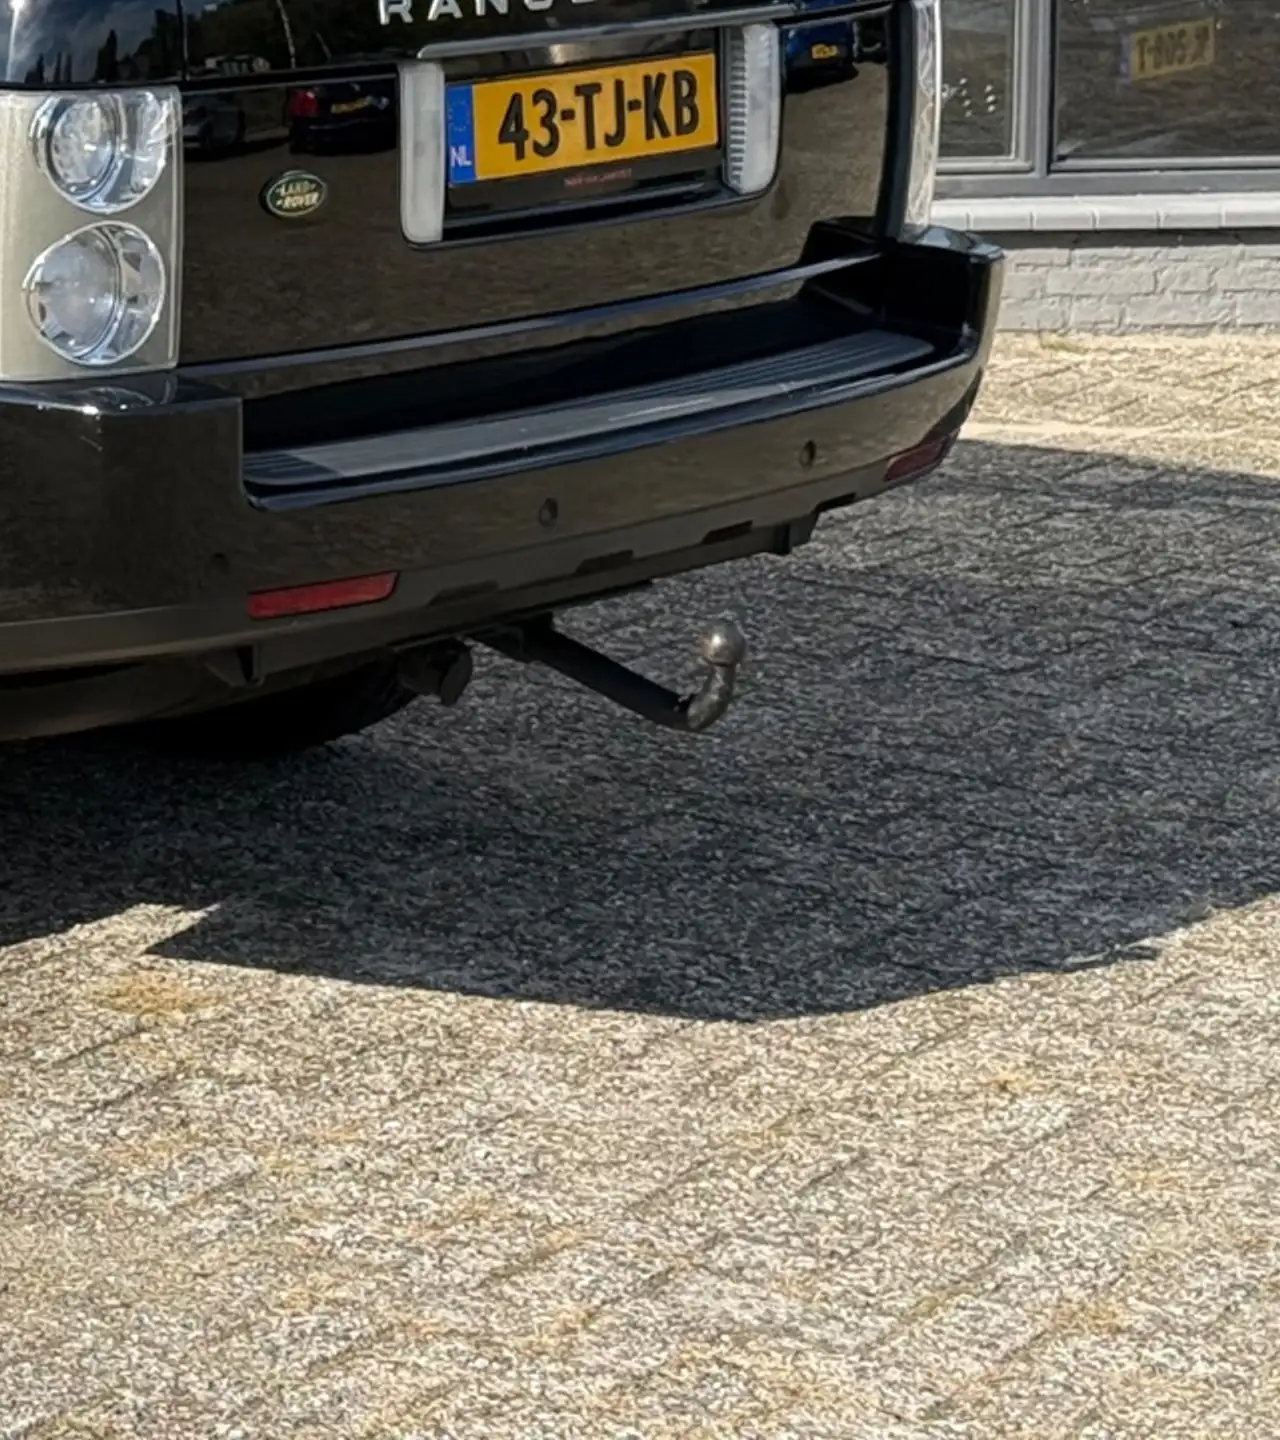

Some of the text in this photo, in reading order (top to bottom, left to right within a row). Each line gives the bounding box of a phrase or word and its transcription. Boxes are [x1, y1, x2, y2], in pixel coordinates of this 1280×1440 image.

[497, 68, 701, 162] 43-TJ-KB
[449, 145, 473, 168] NL
[283, 192, 319, 209] ROVER
